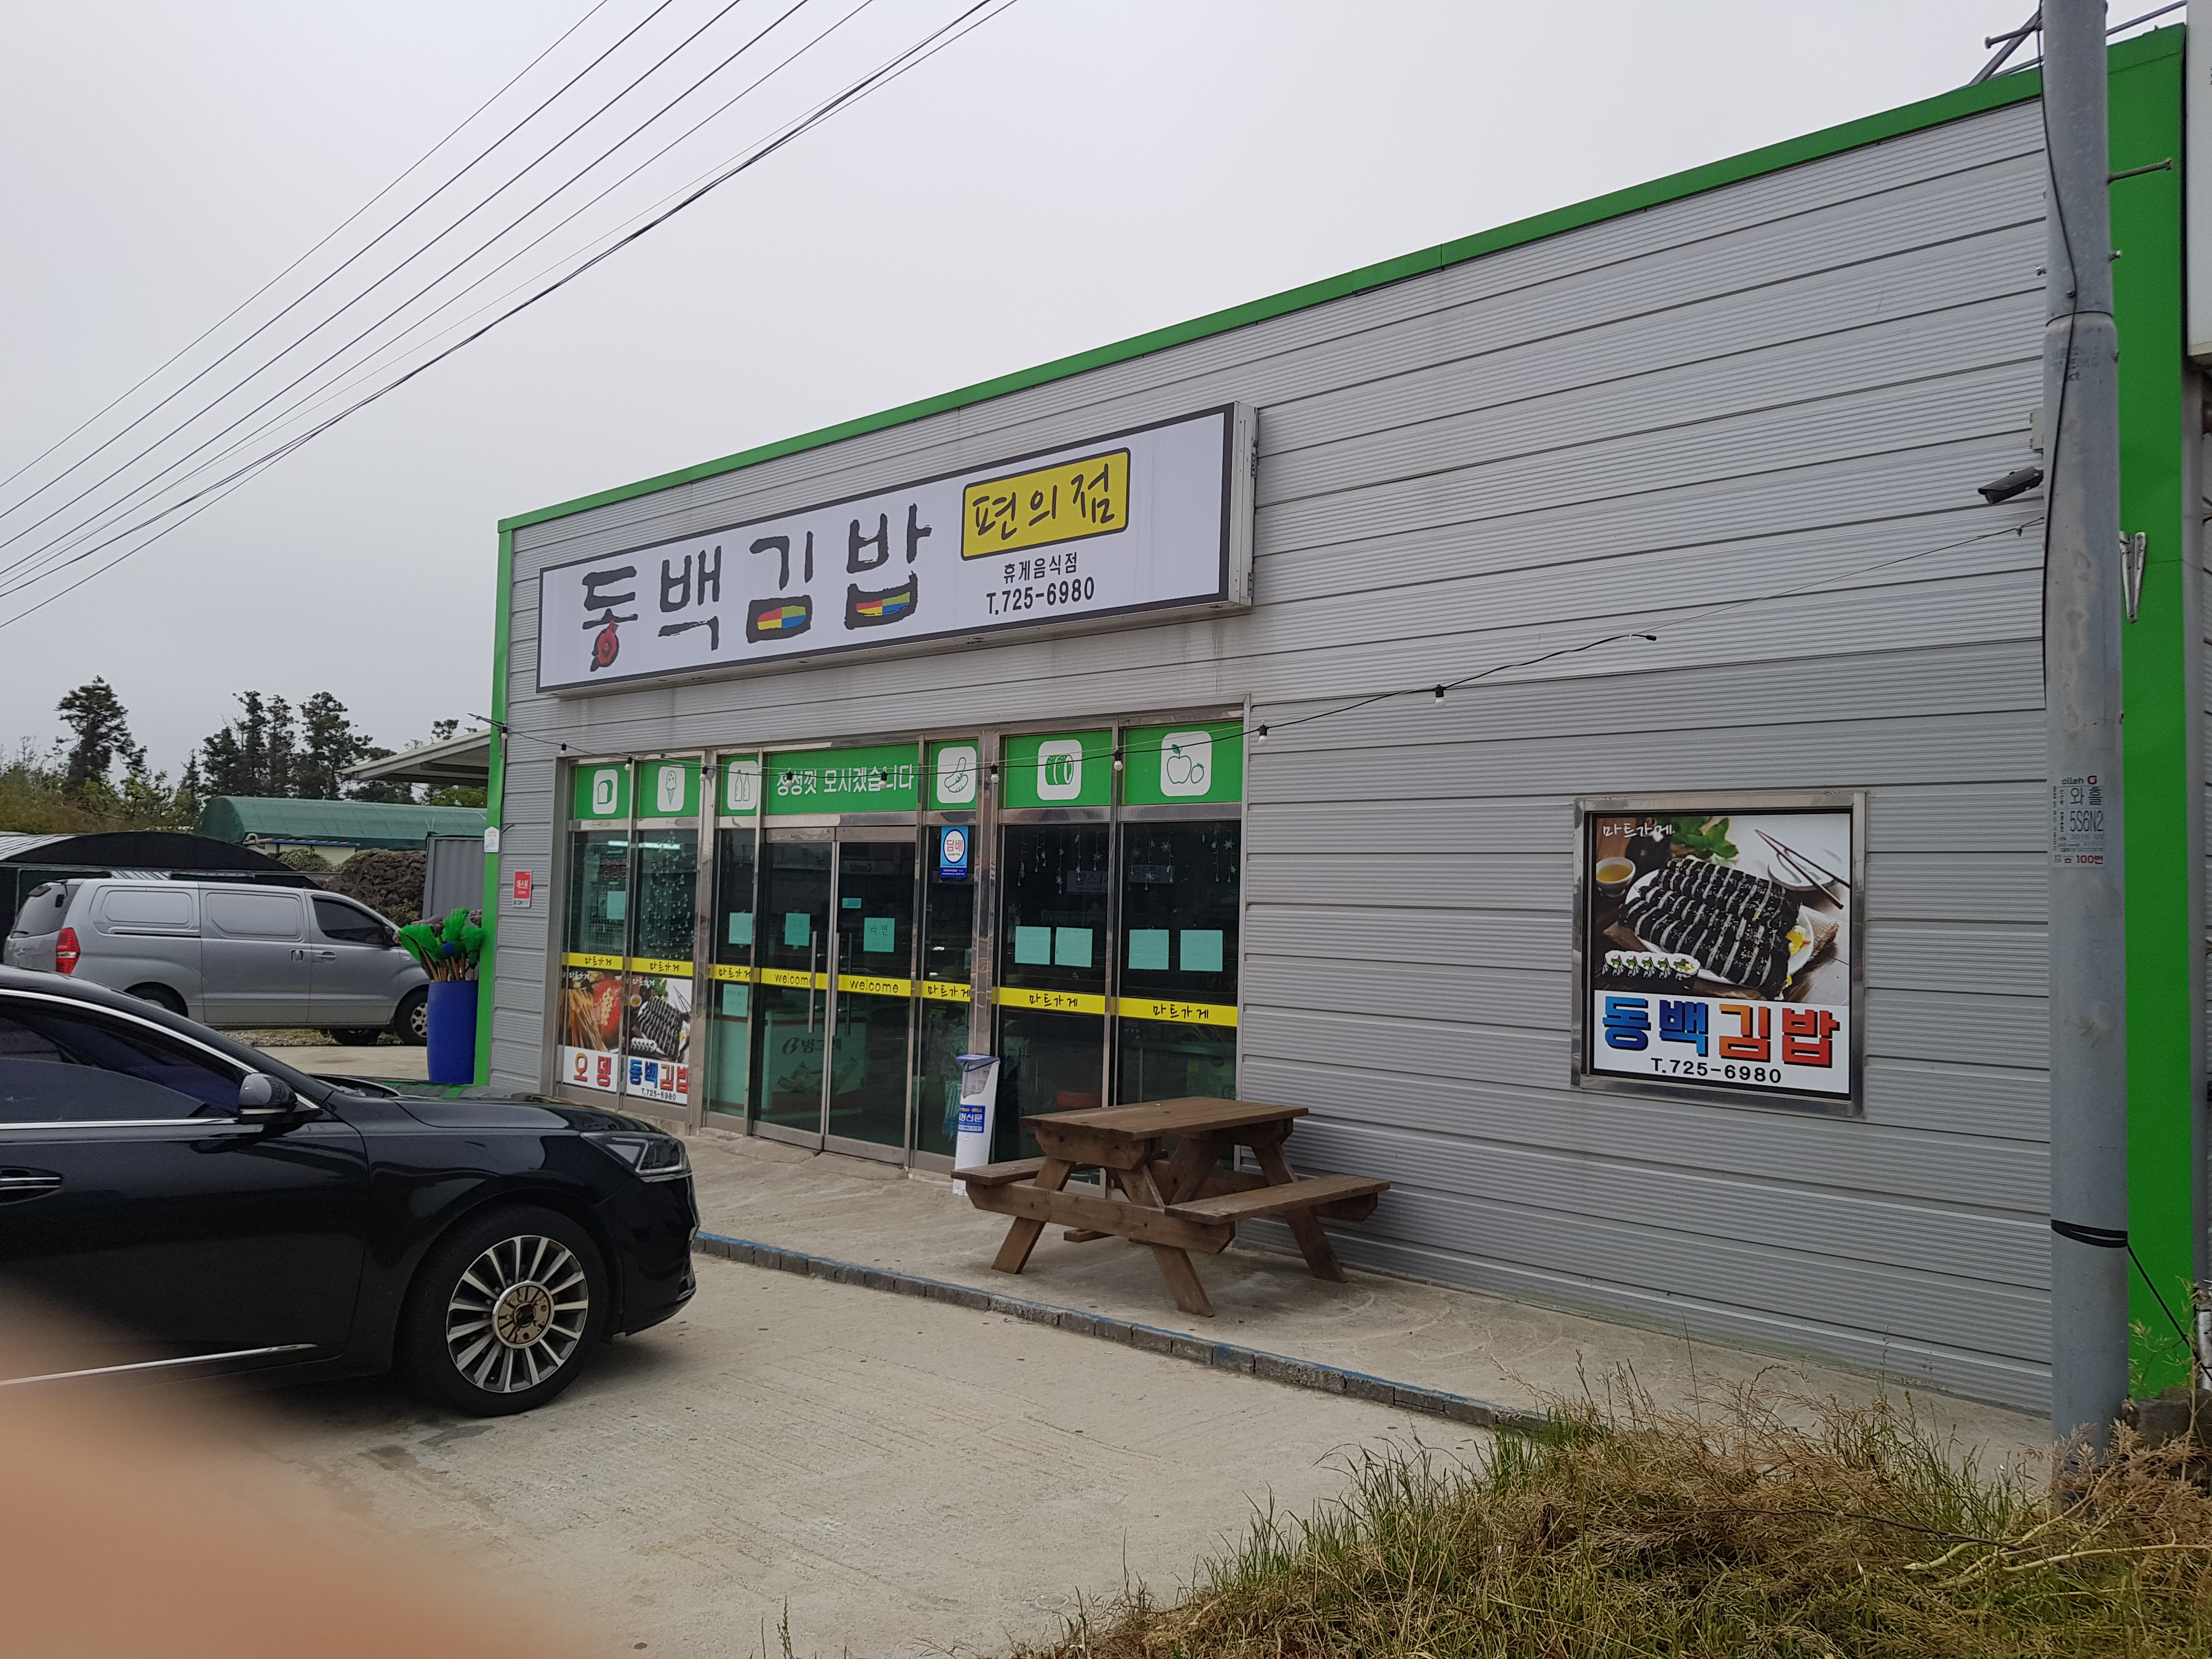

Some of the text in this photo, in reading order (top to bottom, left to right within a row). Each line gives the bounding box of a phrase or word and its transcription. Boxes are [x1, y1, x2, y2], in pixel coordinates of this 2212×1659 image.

[972, 462, 1115, 542] 편의점
[1003, 552, 1077, 584] 휴게음식점
[582, 503, 933, 672] 동백김밥
[986, 577, 1094, 616] T.725-6980
[777, 764, 915, 796] 정성껏 모시겠습니다
[2069, 787, 2103, 805] 와흘
[946, 839, 963, 852] 담배
[2076, 854, 2103, 865] 100번
[870, 923, 888, 936] 라면
[585, 957, 612, 966] 마트가게
[650, 962, 680, 972] 마트가게
[850, 979, 899, 994] welcome
[928, 984, 970, 998] 마트가게
[1029, 993, 1078, 1008] 마트가게
[1153, 1003, 1209, 1020] 마트가게
[1602, 995, 1841, 1068] 동백김밥
[573, 1052, 612, 1087] 오뎅
[1650, 1057, 1781, 1084] T.725-6980
